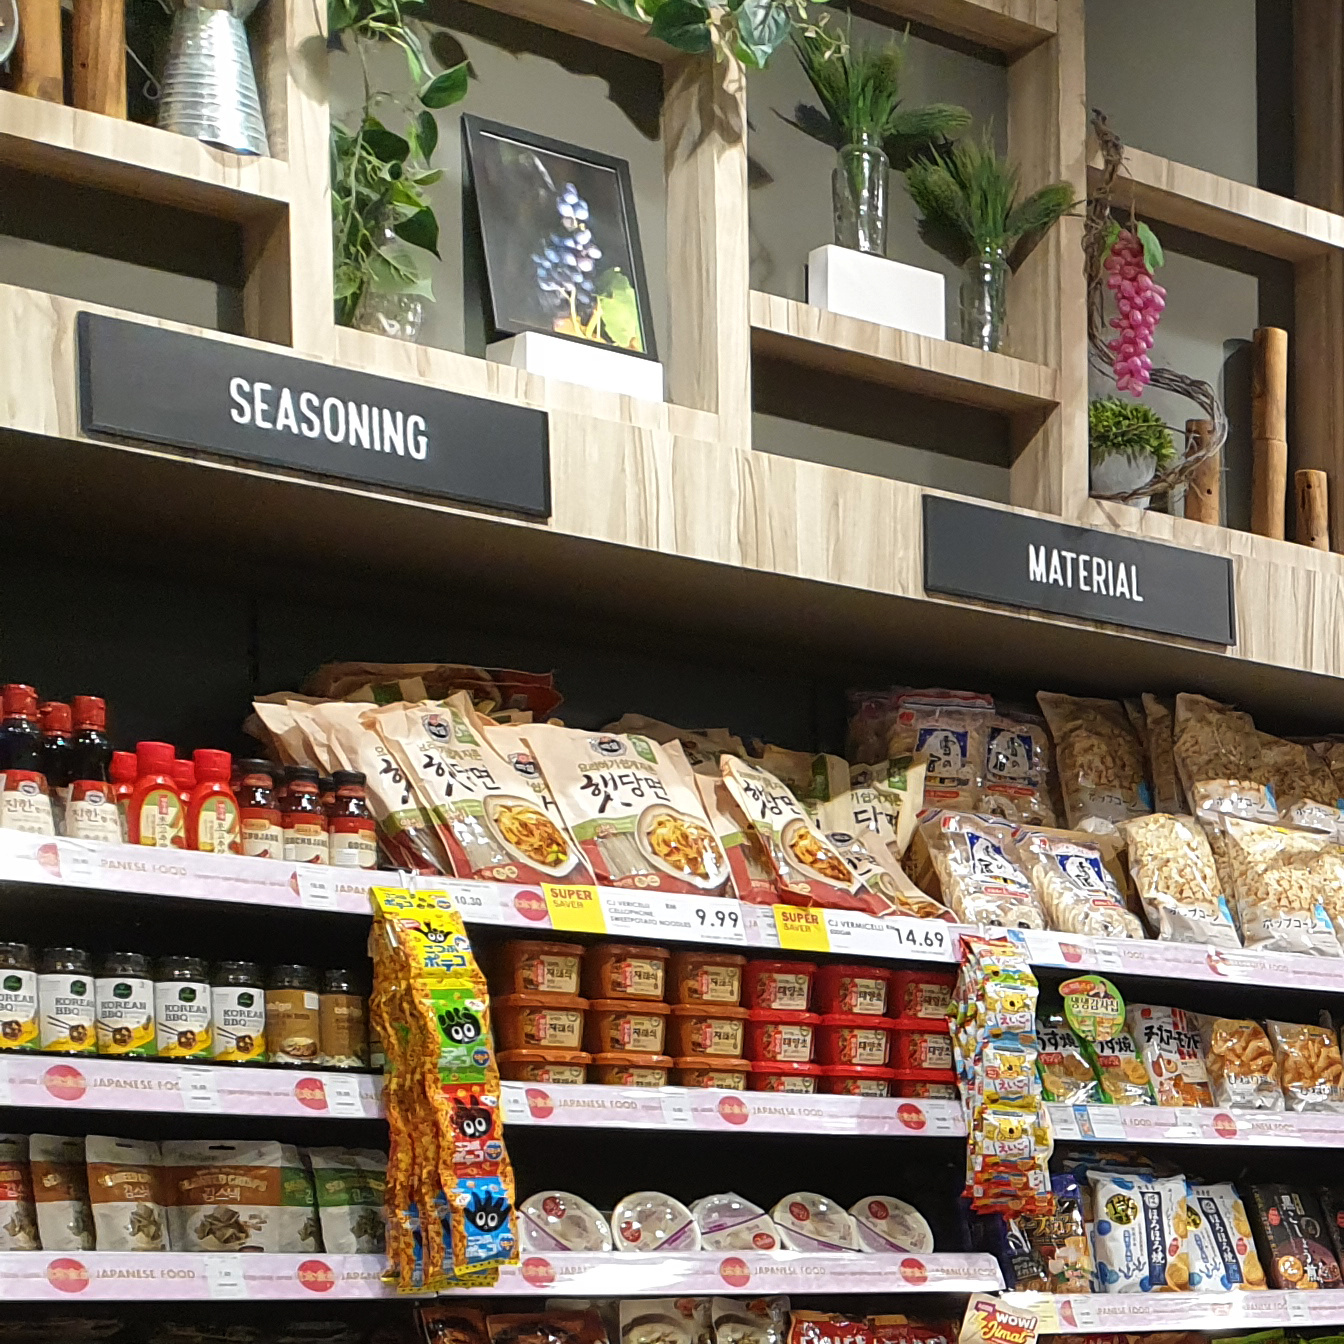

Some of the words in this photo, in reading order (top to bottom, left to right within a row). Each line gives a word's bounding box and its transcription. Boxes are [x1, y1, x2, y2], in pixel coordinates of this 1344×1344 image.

[229, 376, 430, 461] SEASONING
[1028, 544, 1143, 603] MATERIAL
[550, 886, 593, 902] SUPER
[695, 908, 740, 929] 9.99
[782, 910, 820, 925] SUPER
[894, 927, 945, 949] 14.69
[55, 1006, 80, 1016] BBQ
[101, 1001, 147, 1011] KOREAN
[164, 1004, 208, 1014] KOREAN
[165, 1013, 188, 1022] BBQ
[223, 1009, 265, 1019] KOREAN
[223, 1018, 247, 1027] BBQ
[97, 1268, 156, 1280] JAPANESE
[160, 1268, 196, 1280] FOOD
